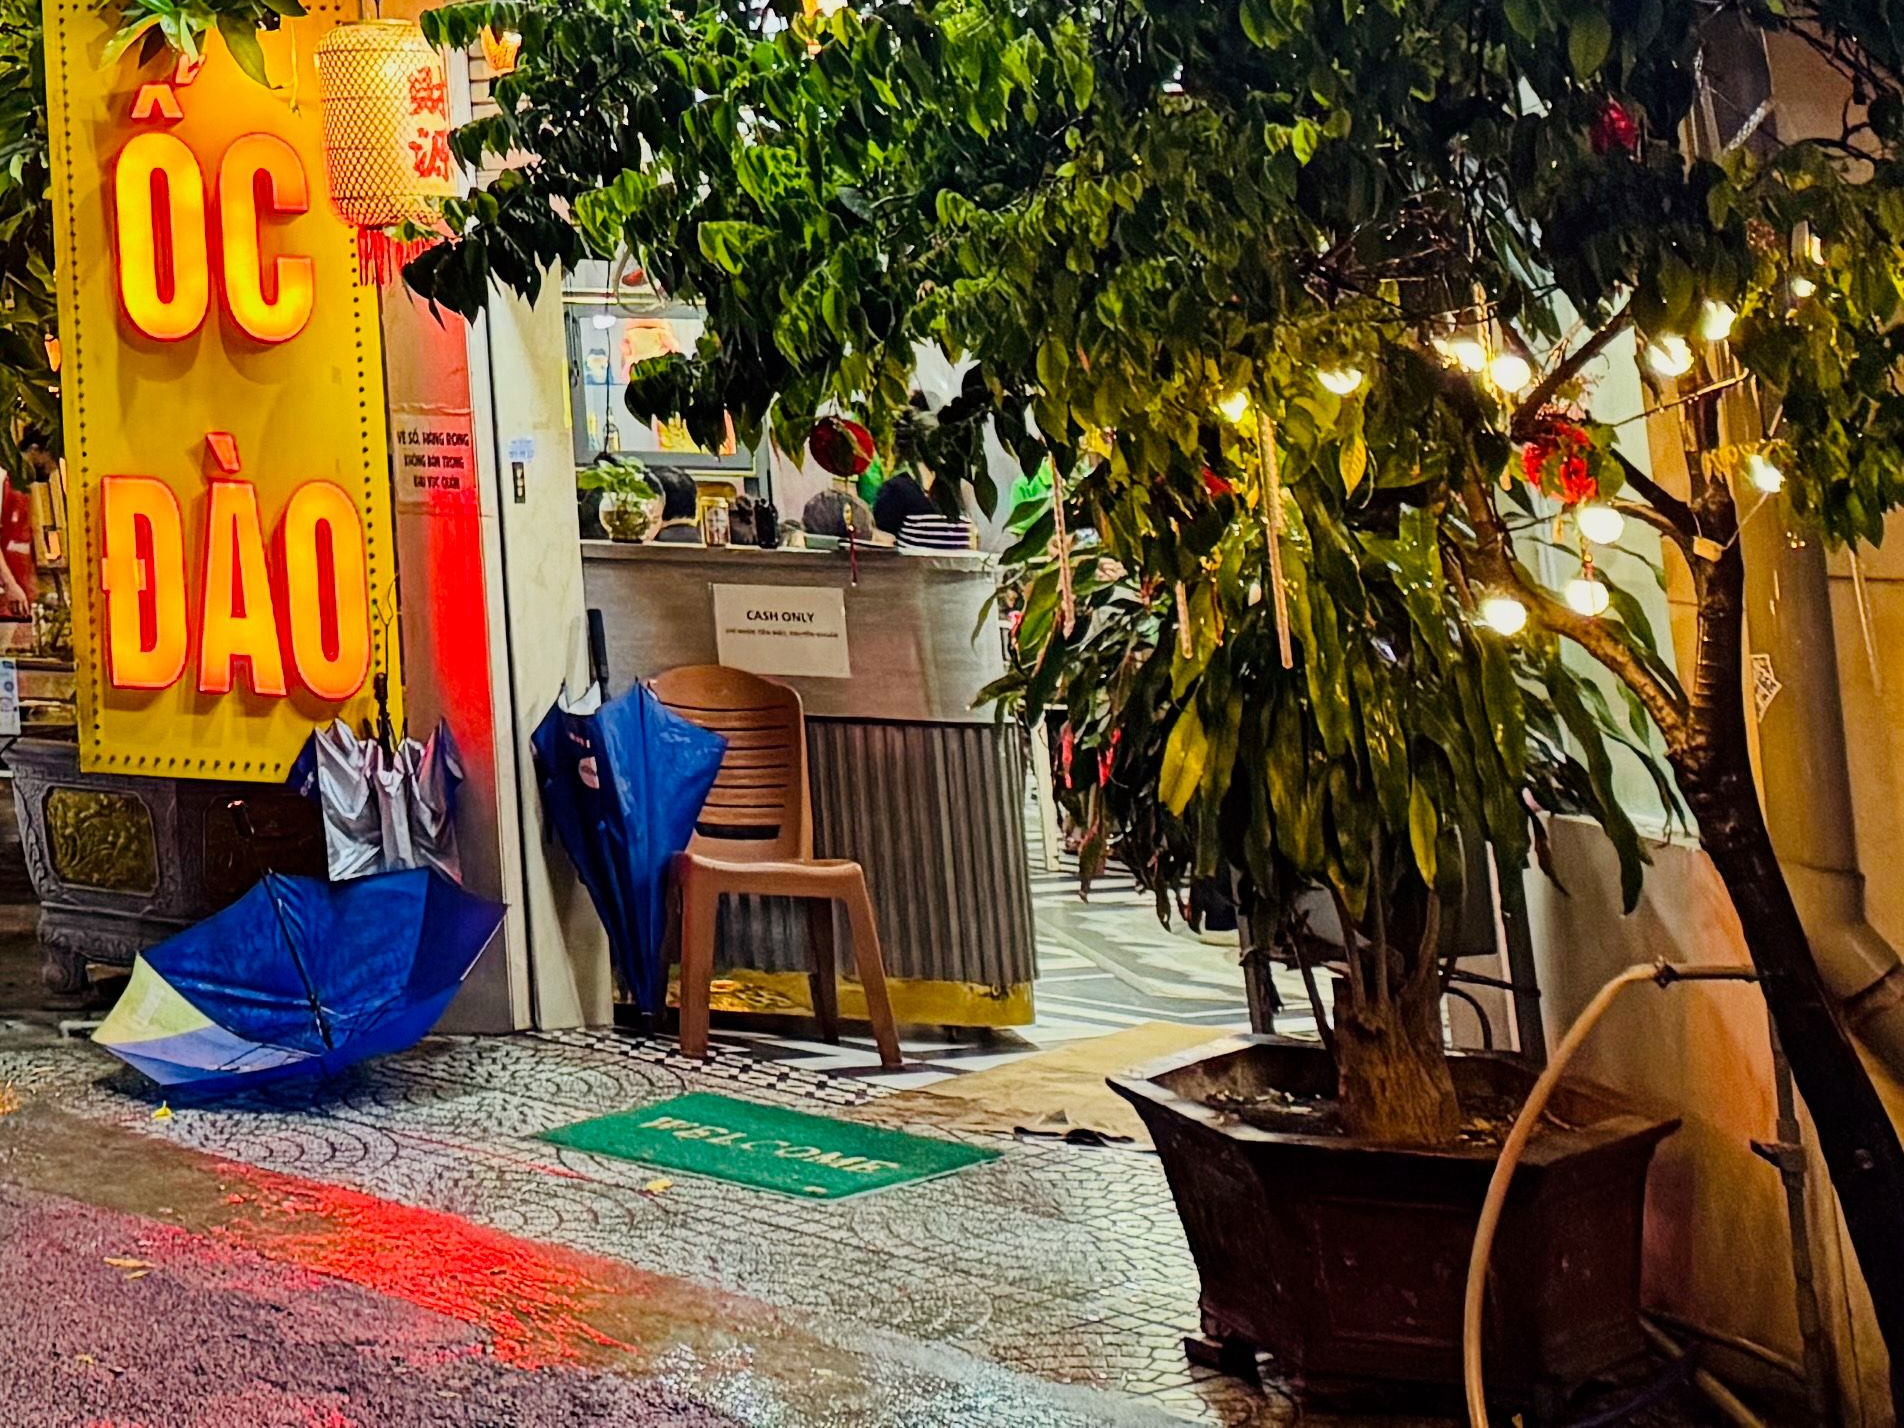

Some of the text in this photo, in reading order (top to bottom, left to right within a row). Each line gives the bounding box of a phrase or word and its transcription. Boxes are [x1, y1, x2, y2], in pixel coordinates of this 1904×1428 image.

[113, 53, 317, 343] ỐC
[100, 430, 374, 702] ĐÀO
[746, 609, 815, 624] CASH ONLY
[639, 1116, 902, 1174] WELCOME
